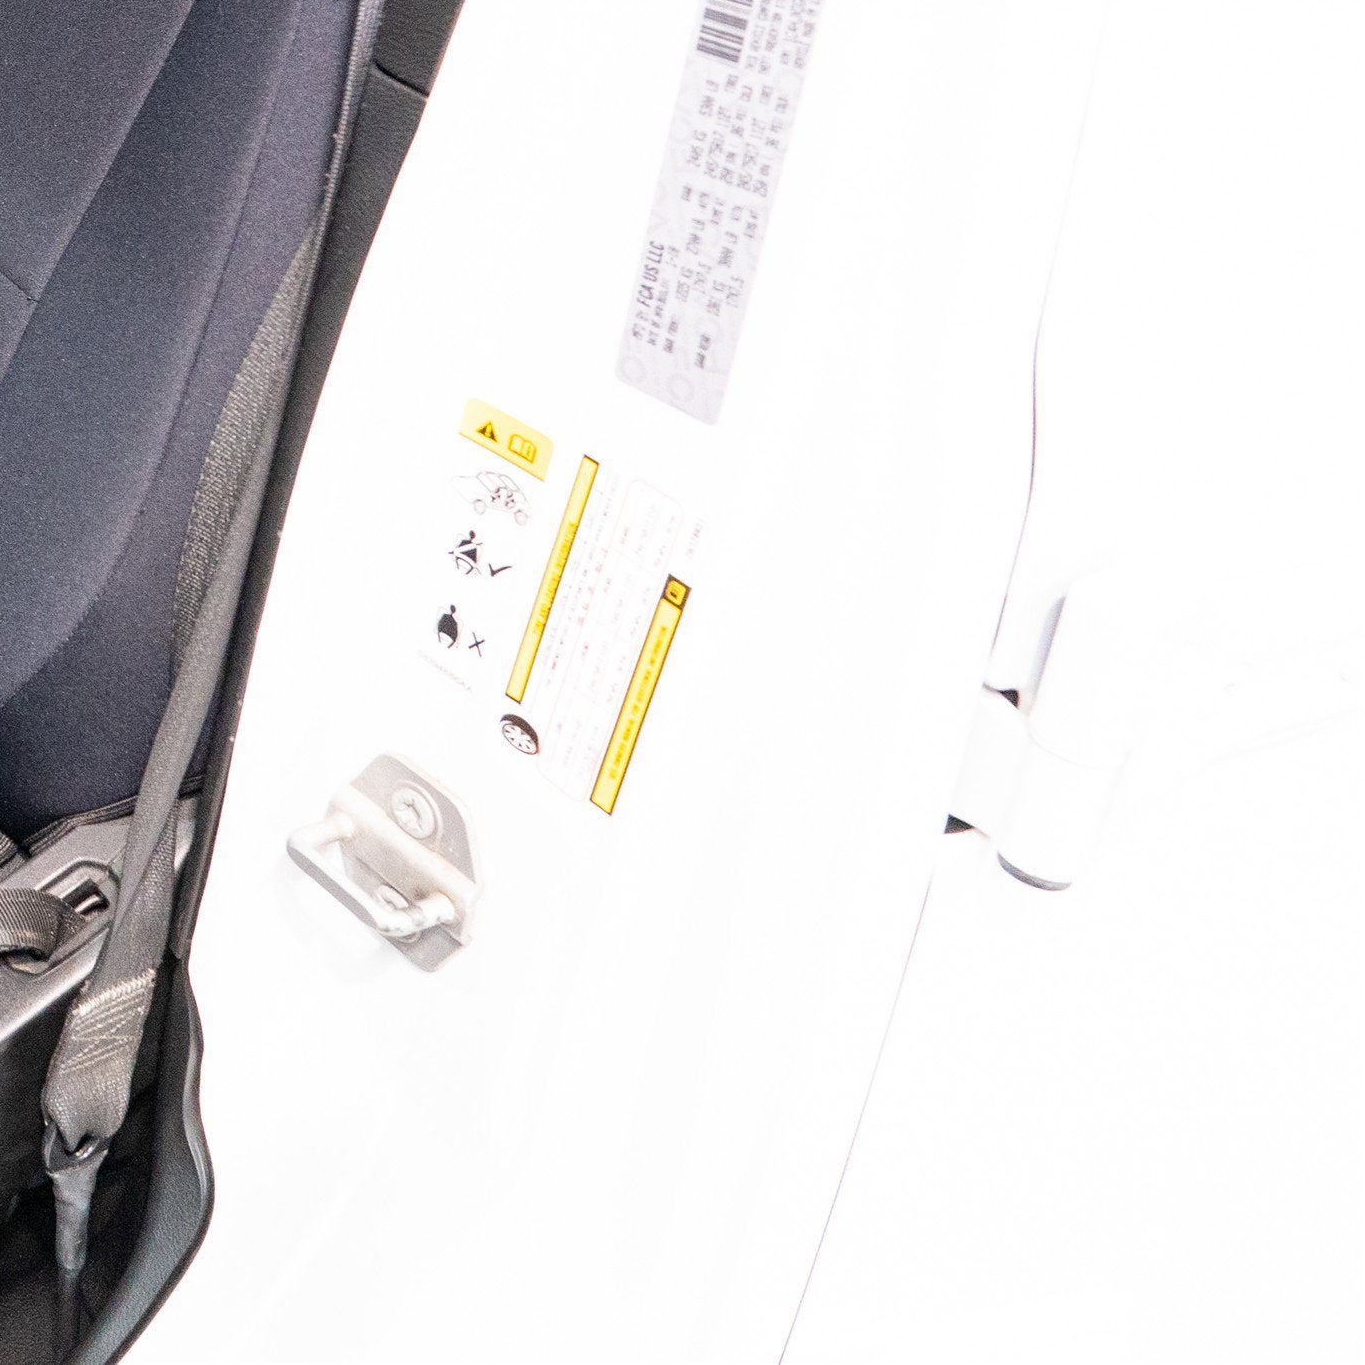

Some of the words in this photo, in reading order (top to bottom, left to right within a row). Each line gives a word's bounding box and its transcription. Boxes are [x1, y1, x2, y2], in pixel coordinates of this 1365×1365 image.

[646, 240, 665, 264] LLC
[642, 264, 660, 283] US
[636, 283, 655, 308] FCA
